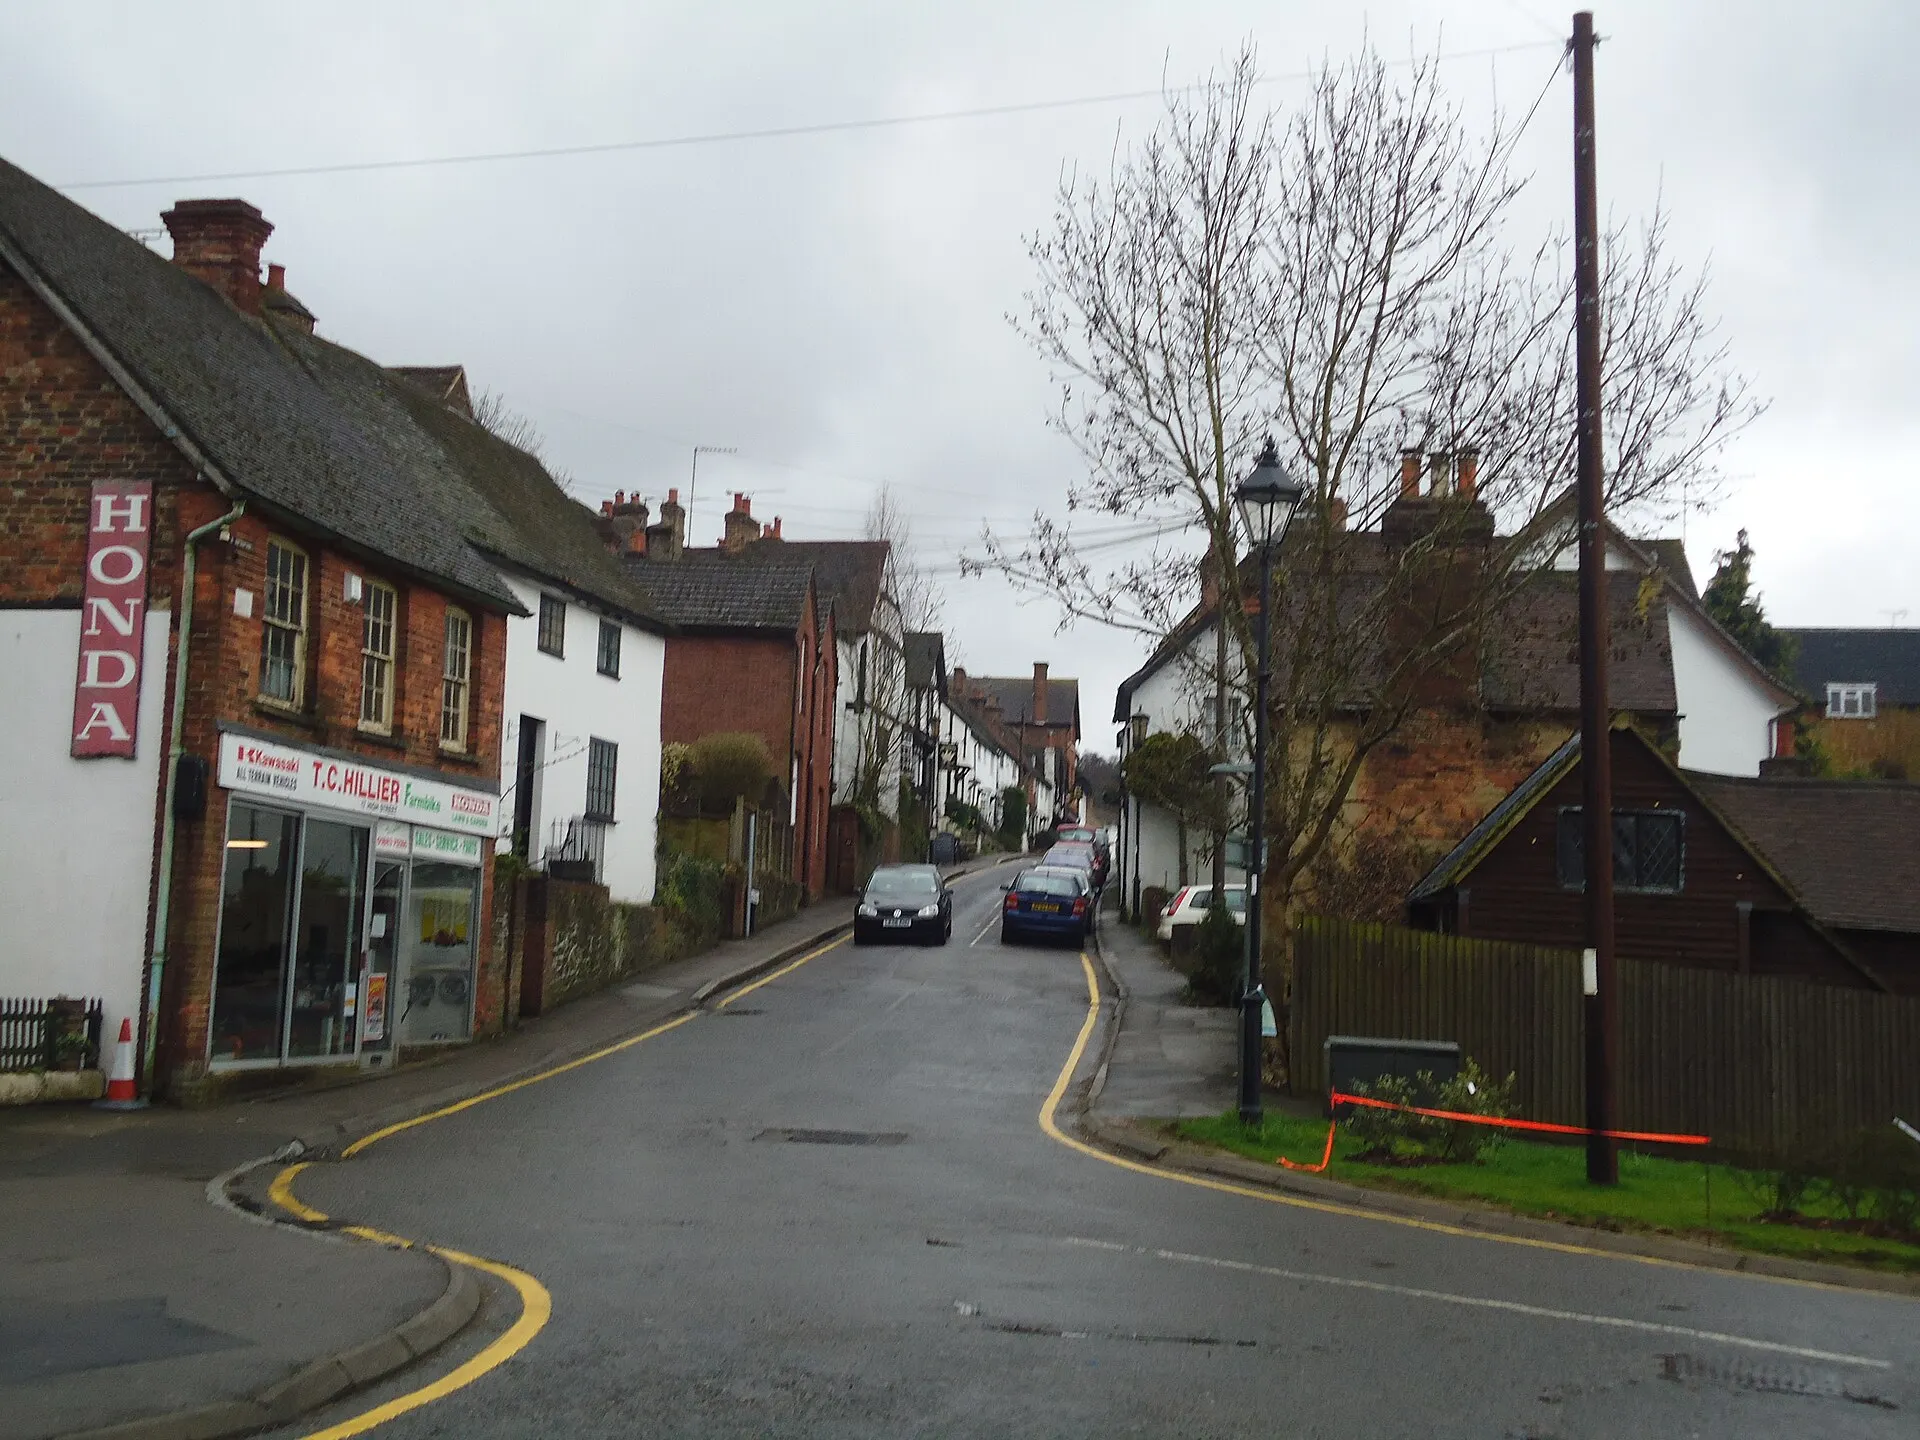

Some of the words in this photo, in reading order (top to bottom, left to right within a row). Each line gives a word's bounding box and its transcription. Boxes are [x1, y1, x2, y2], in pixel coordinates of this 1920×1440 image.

[76, 494, 148, 741] HONDA
[255, 749, 300, 774] Kawasaki
[451, 793, 491, 816] HONDA
